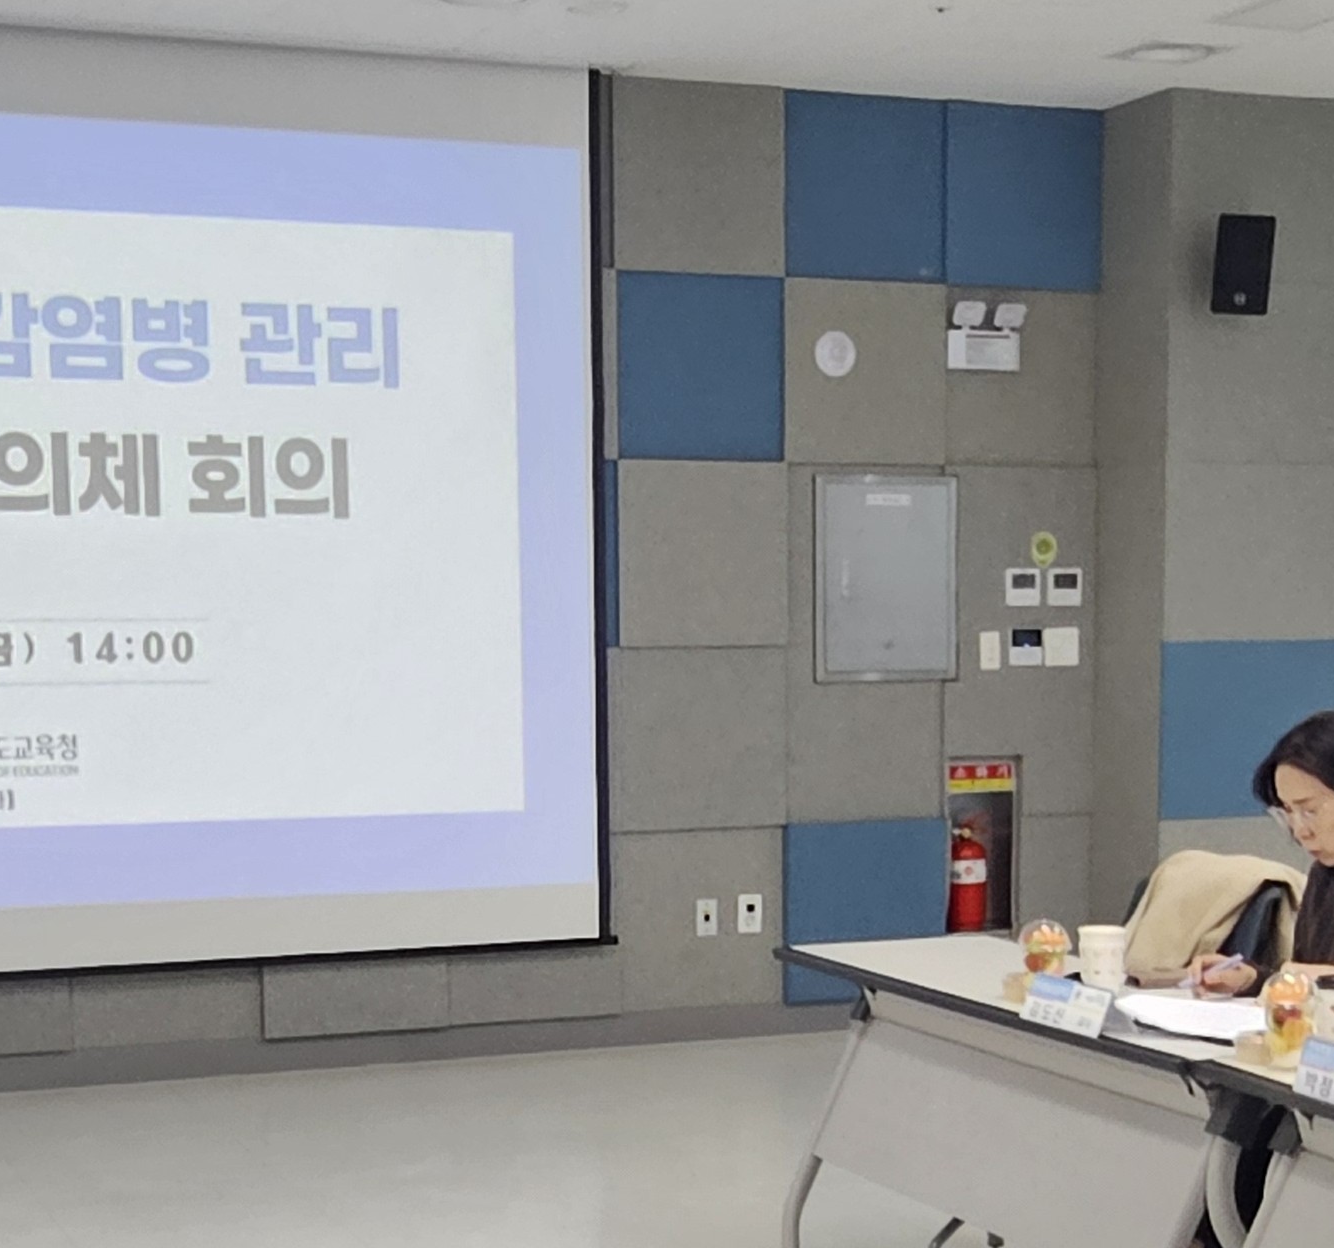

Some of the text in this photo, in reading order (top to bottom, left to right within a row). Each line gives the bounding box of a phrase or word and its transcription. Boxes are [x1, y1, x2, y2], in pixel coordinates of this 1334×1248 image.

[240, 302, 400, 388] 관리
[188, 434, 350, 519] 회의
[67, 630, 195, 664] 14:00
[13, 765, 80, 778] EDUCATION
